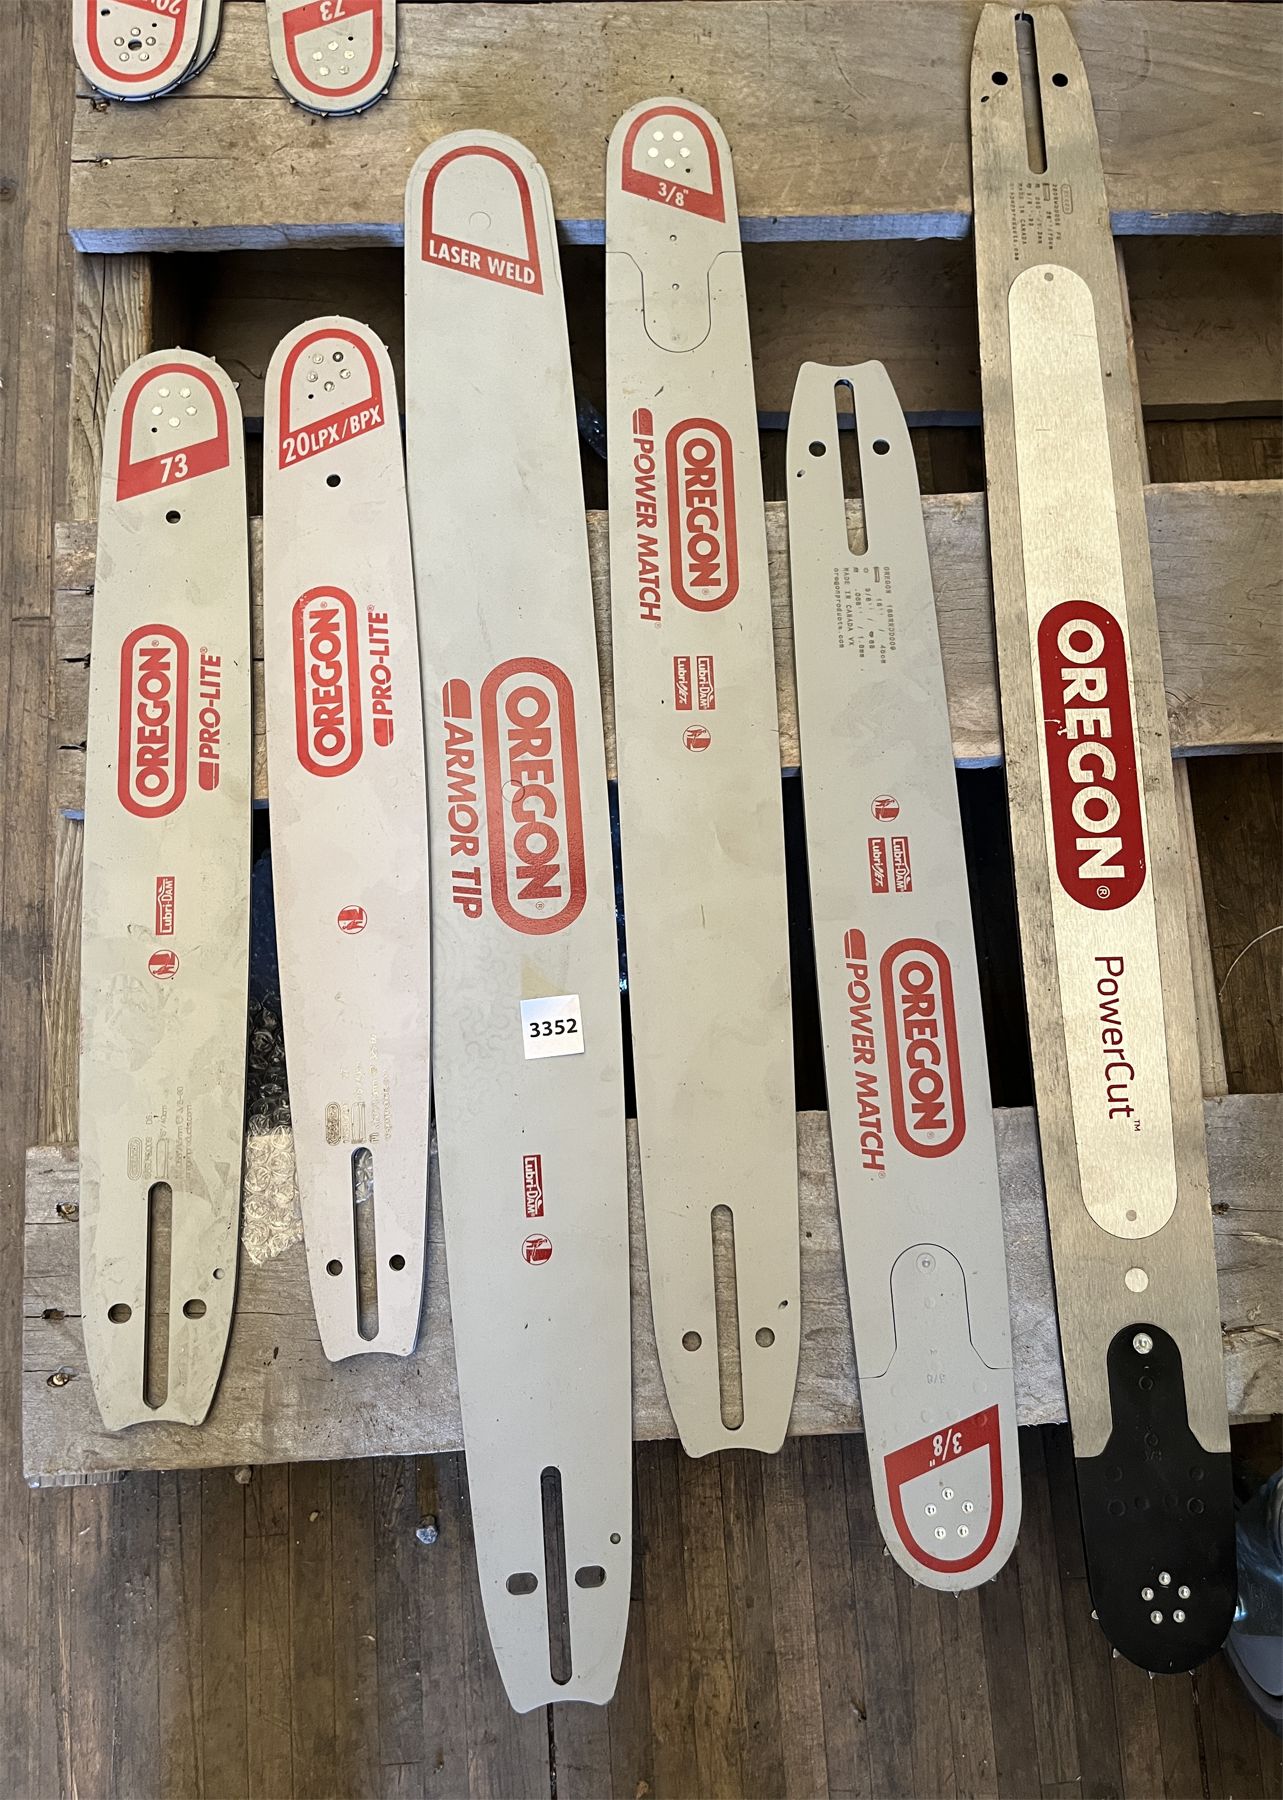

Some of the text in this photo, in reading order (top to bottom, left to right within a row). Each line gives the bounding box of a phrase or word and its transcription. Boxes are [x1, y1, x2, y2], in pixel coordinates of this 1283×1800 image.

[319, 0, 346, 21] 73
[658, 182, 689, 207] 3/8"
[428, 239, 536, 285] LASER WELD
[282, 404, 382, 464] 20LPX/BPX
[160, 453, 189, 484] 73
[633, 438, 661, 622] POWER MATCH
[845, 604, 853, 632] CANADA
[368, 611, 393, 717] PRO-LITE
[199, 654, 221, 761] PRO-LITE
[443, 721, 482, 919] ARMOR TIP
[529, 1018, 578, 1038] 3352
[848, 962, 884, 1171] POWER MATCH
[929, 1428, 962, 1467] 3/8"
